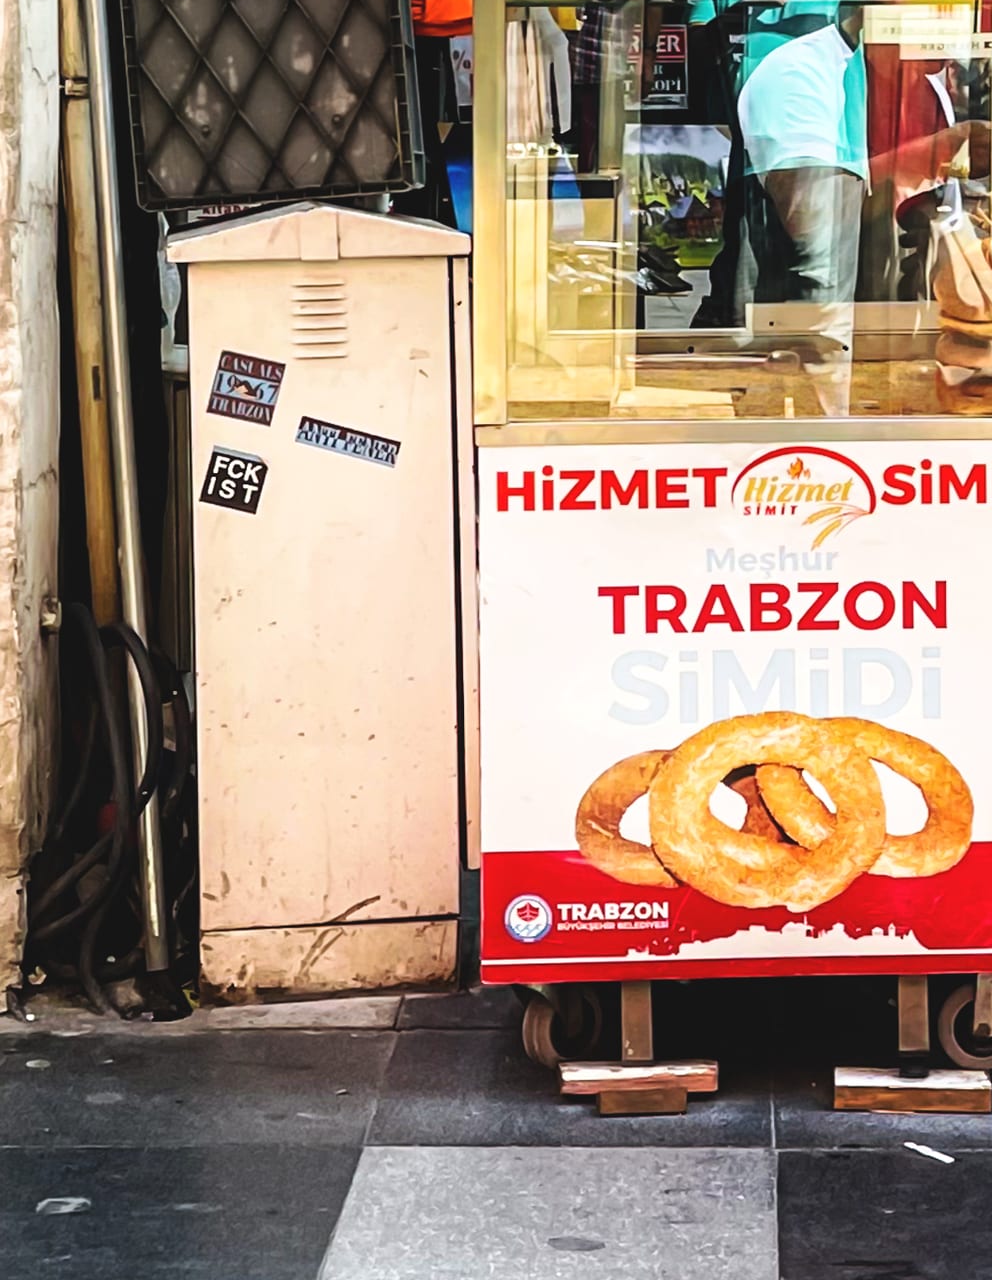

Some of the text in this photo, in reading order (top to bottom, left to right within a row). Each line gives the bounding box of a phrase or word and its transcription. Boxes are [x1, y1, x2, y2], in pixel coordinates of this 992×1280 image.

[216, 373, 279, 404] 1967
[212, 396, 272, 422] TRABZON
[298, 421, 398, 465] ANTI FENER
[213, 455, 262, 483] FCK
[744, 476, 853, 503] Hizmet
[706, 546, 838, 579] Meşhur
[598, 581, 947, 634] TRABZON
[557, 902, 669, 920] TRABZON
